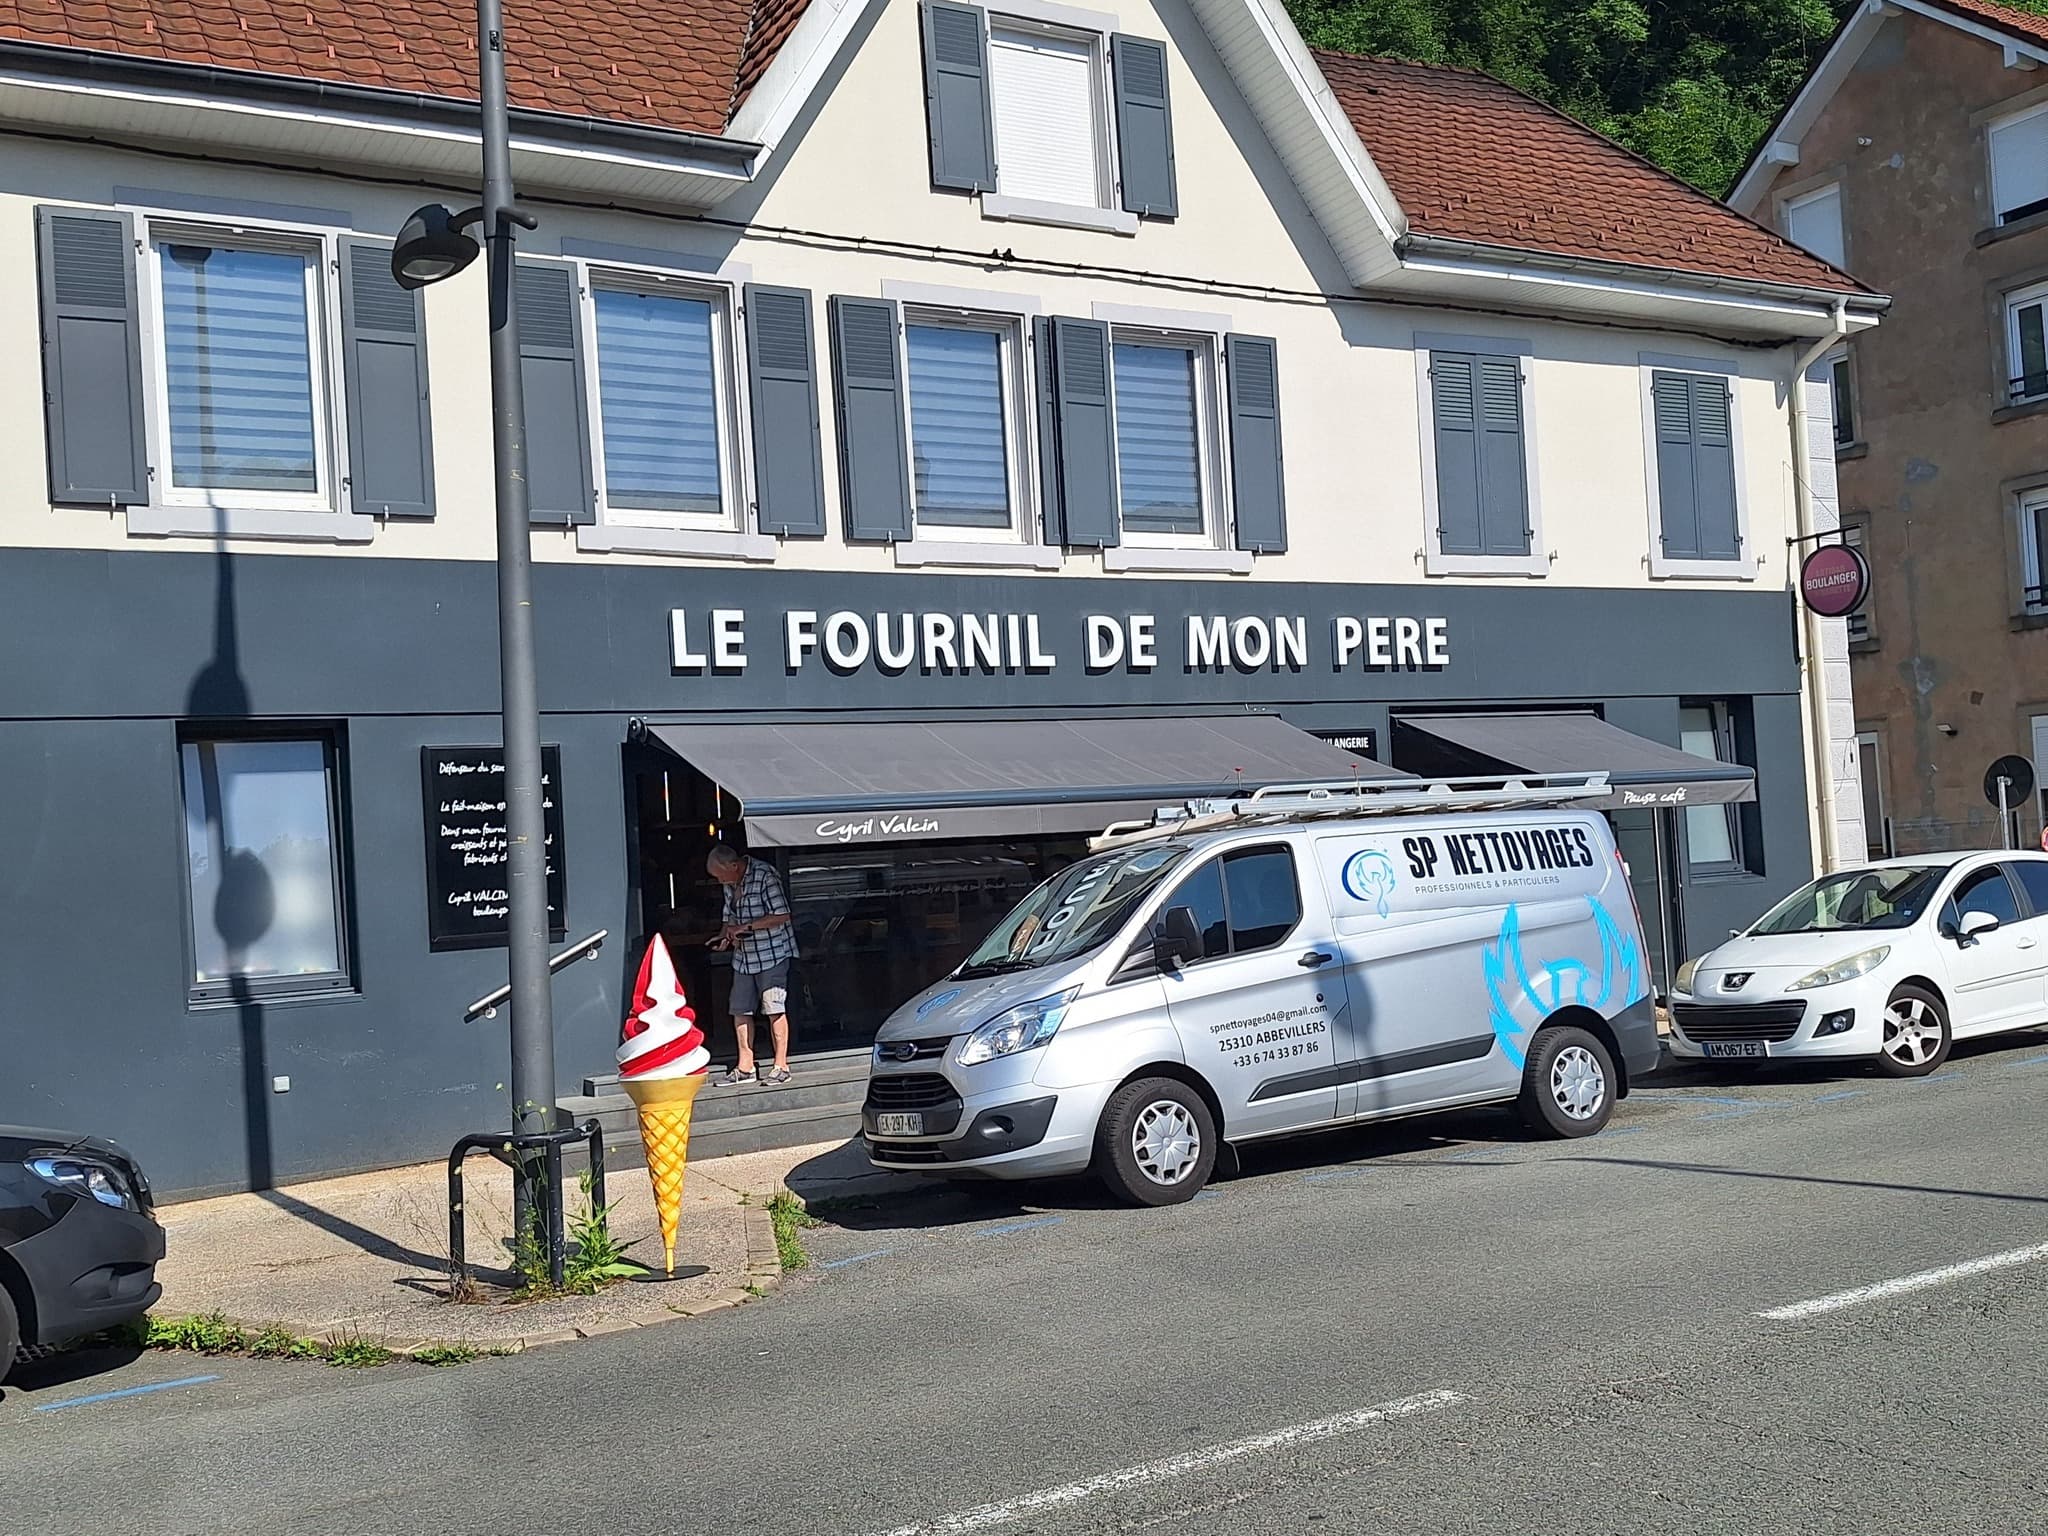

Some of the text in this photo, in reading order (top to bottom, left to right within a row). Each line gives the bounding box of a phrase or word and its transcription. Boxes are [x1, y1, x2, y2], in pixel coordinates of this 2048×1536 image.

[1806, 570, 1857, 590] BOULANGER
[671, 607, 1451, 669] LE FOURNIL DE MON PERE
[477, 761, 489, 773] du
[1623, 786, 1687, 805] Pause café
[815, 814, 940, 843] Cyril Valcin
[1402, 828, 1594, 879] SP NETTOYAGES
[1414, 875, 1561, 895] PROFESSIONNELS & PARTICULIERS
[1209, 1003, 1328, 1035] spnettoyages04@gmail.com
[1218, 1020, 1326, 1052] 25310 ABBEVILLERS
[1232, 1041, 1319, 1069] +33 6 74 33 87 86
